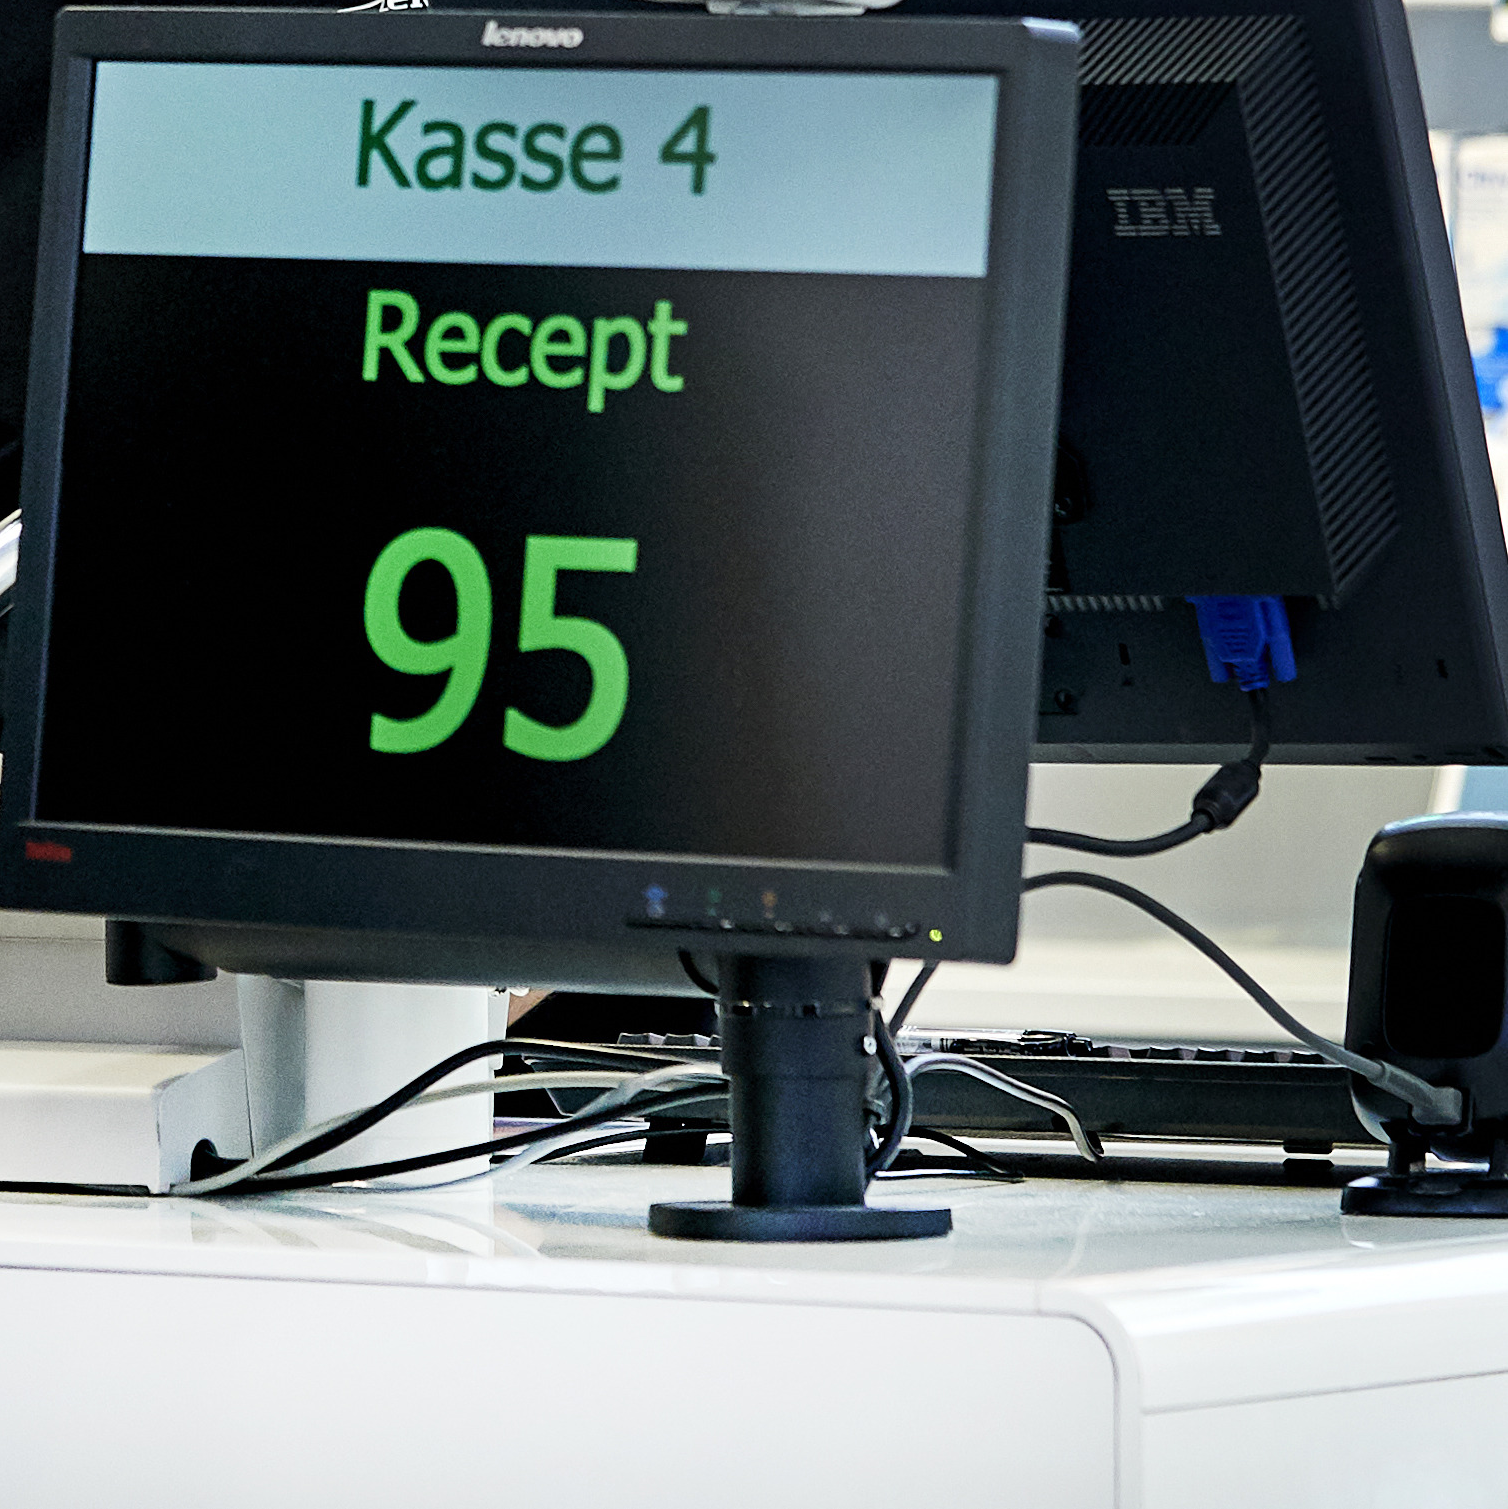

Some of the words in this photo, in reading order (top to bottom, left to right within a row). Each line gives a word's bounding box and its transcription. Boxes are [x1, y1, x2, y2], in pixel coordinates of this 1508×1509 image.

[481, 19, 585, 48] lenovo
[355, 97, 623, 194] Kasse
[658, 104, 717, 195] 4
[1105, 187, 1222, 237] IBM
[362, 288, 688, 413] Recept
[363, 526, 639, 762] 95
